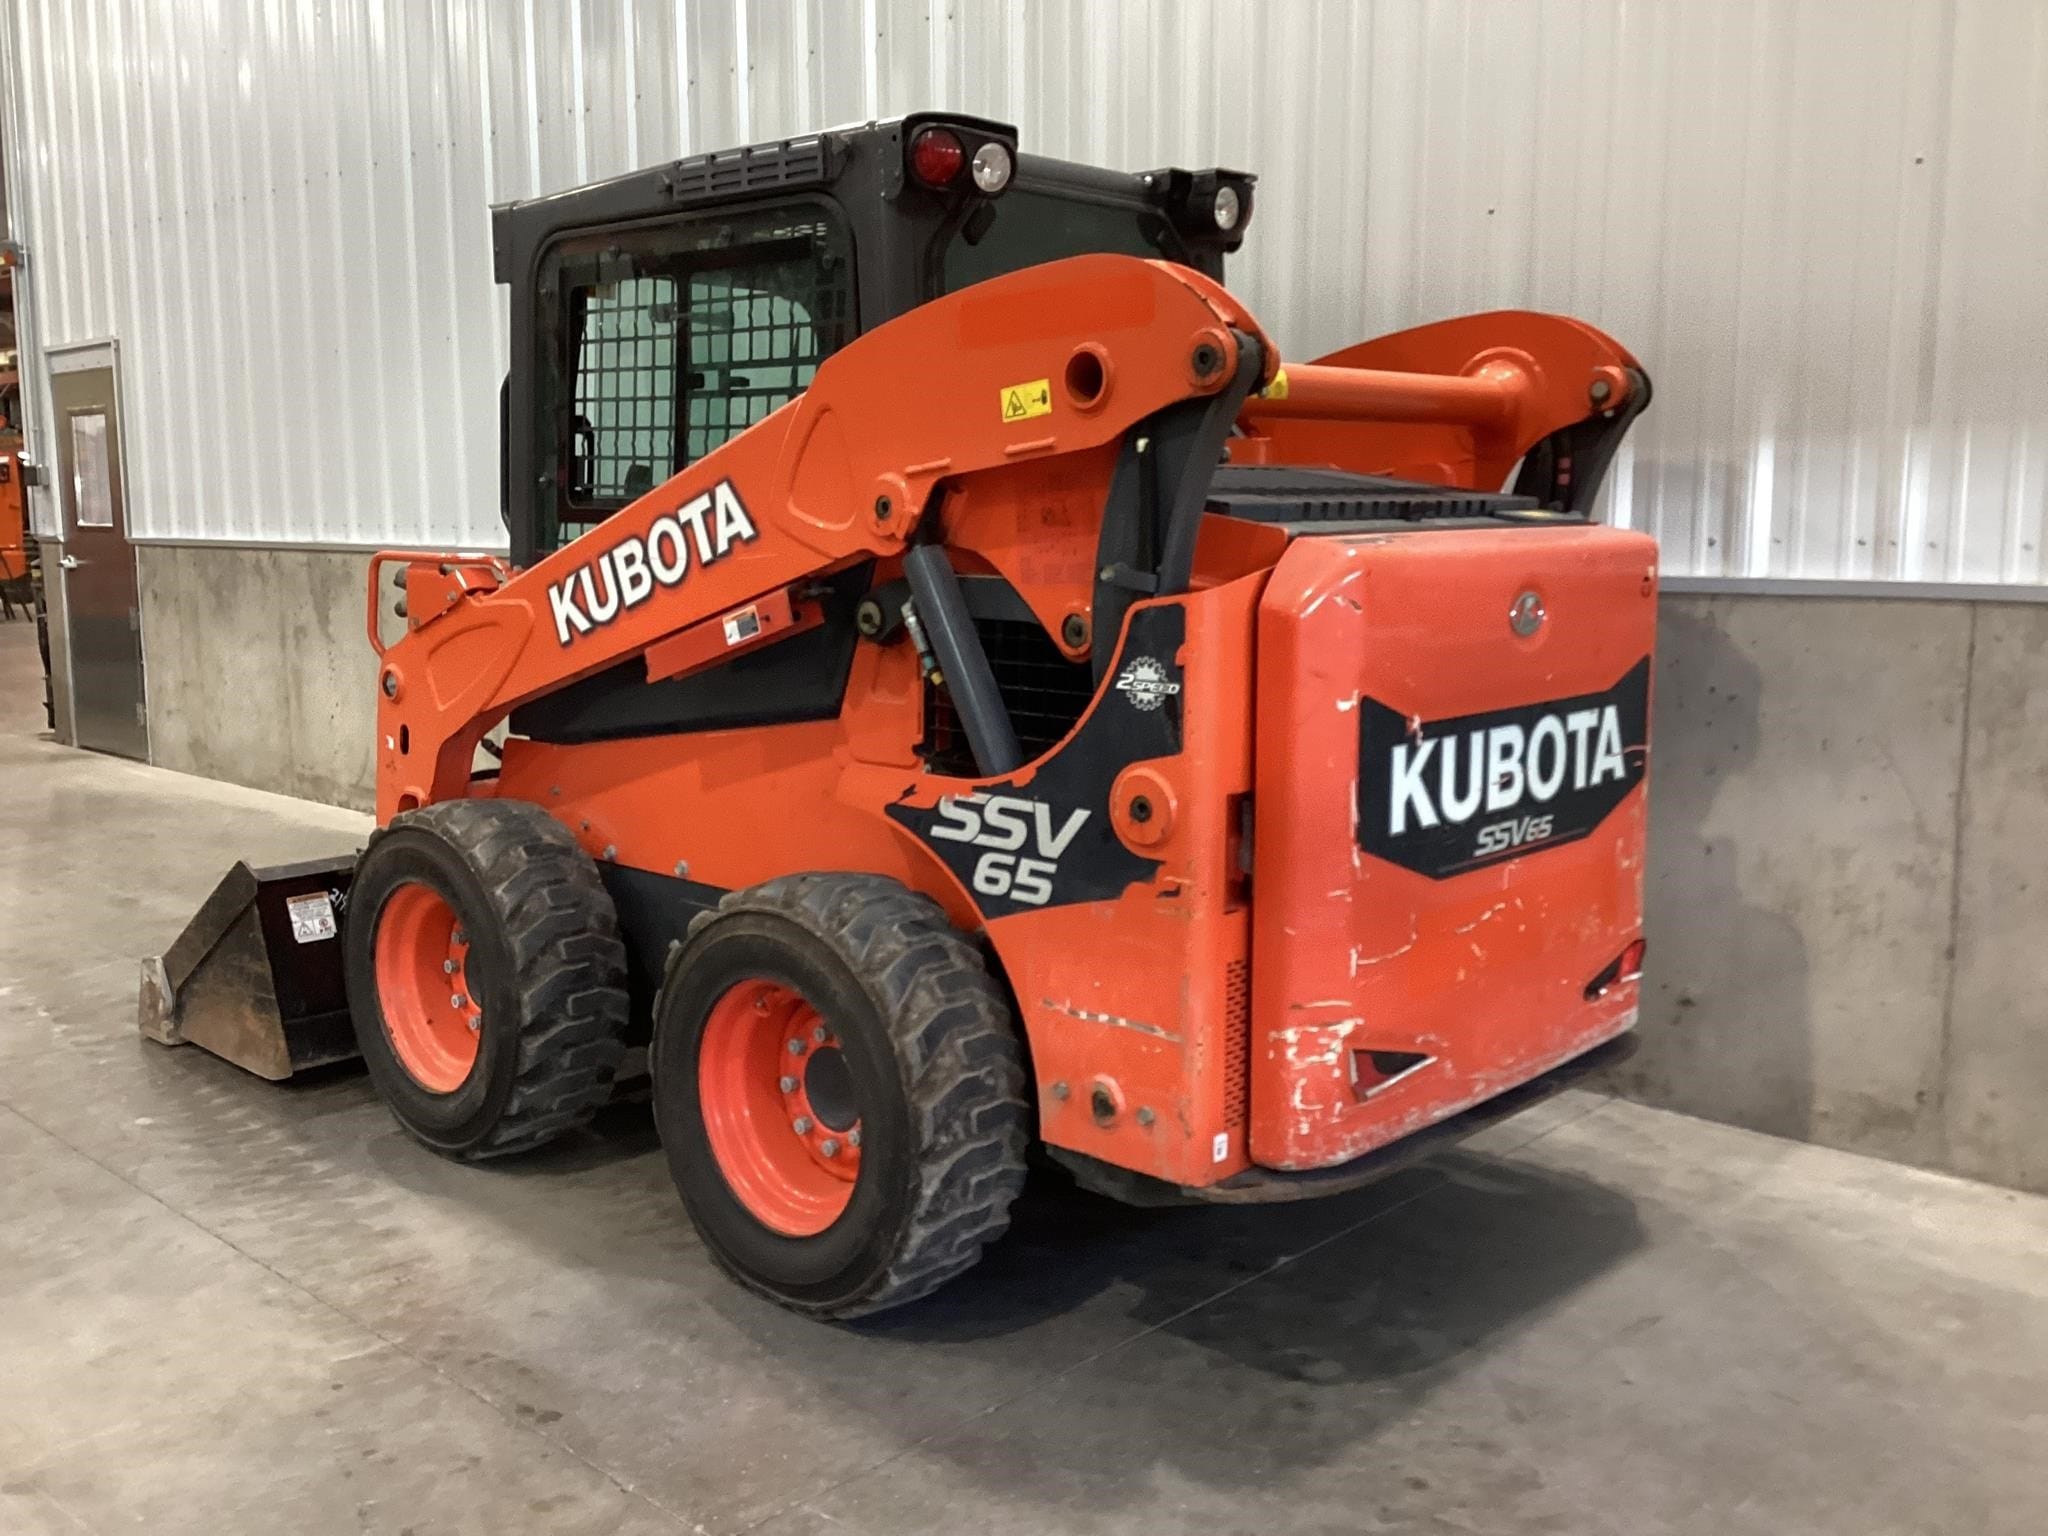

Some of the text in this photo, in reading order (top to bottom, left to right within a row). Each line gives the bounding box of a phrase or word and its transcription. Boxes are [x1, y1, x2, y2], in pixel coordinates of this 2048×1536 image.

[547, 480, 756, 644] KUBOTA
[1388, 704, 1626, 836] KUBOTA
[930, 791, 1092, 859] SSV
[972, 851, 1058, 906] 65
